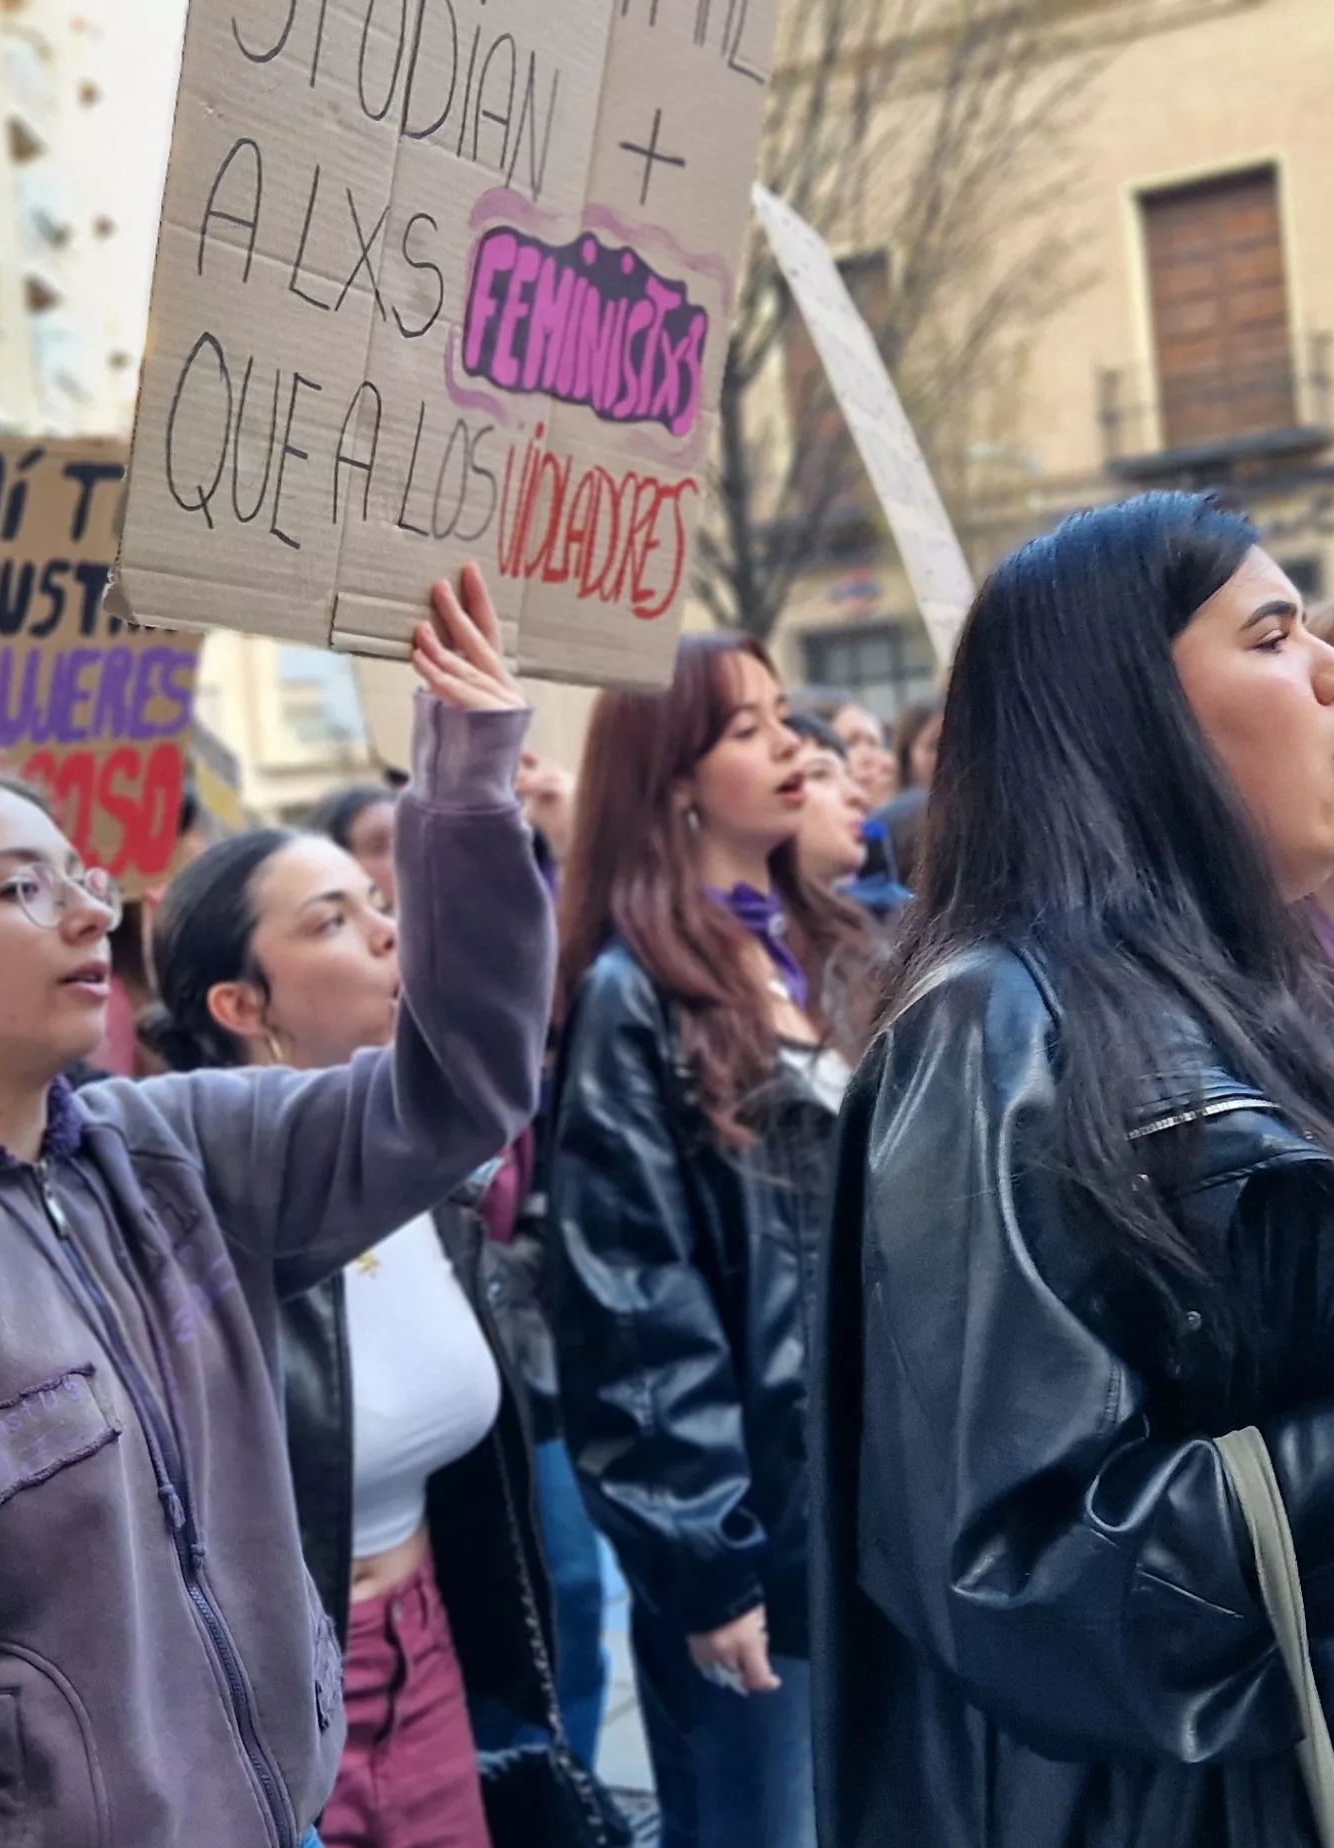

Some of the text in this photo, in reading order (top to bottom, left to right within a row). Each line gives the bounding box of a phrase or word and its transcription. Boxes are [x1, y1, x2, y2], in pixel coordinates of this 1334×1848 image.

[197, 136, 708, 438] A LXS FEMINISTXS
[165, 331, 699, 620] QUE A LOS VIOLADORES
